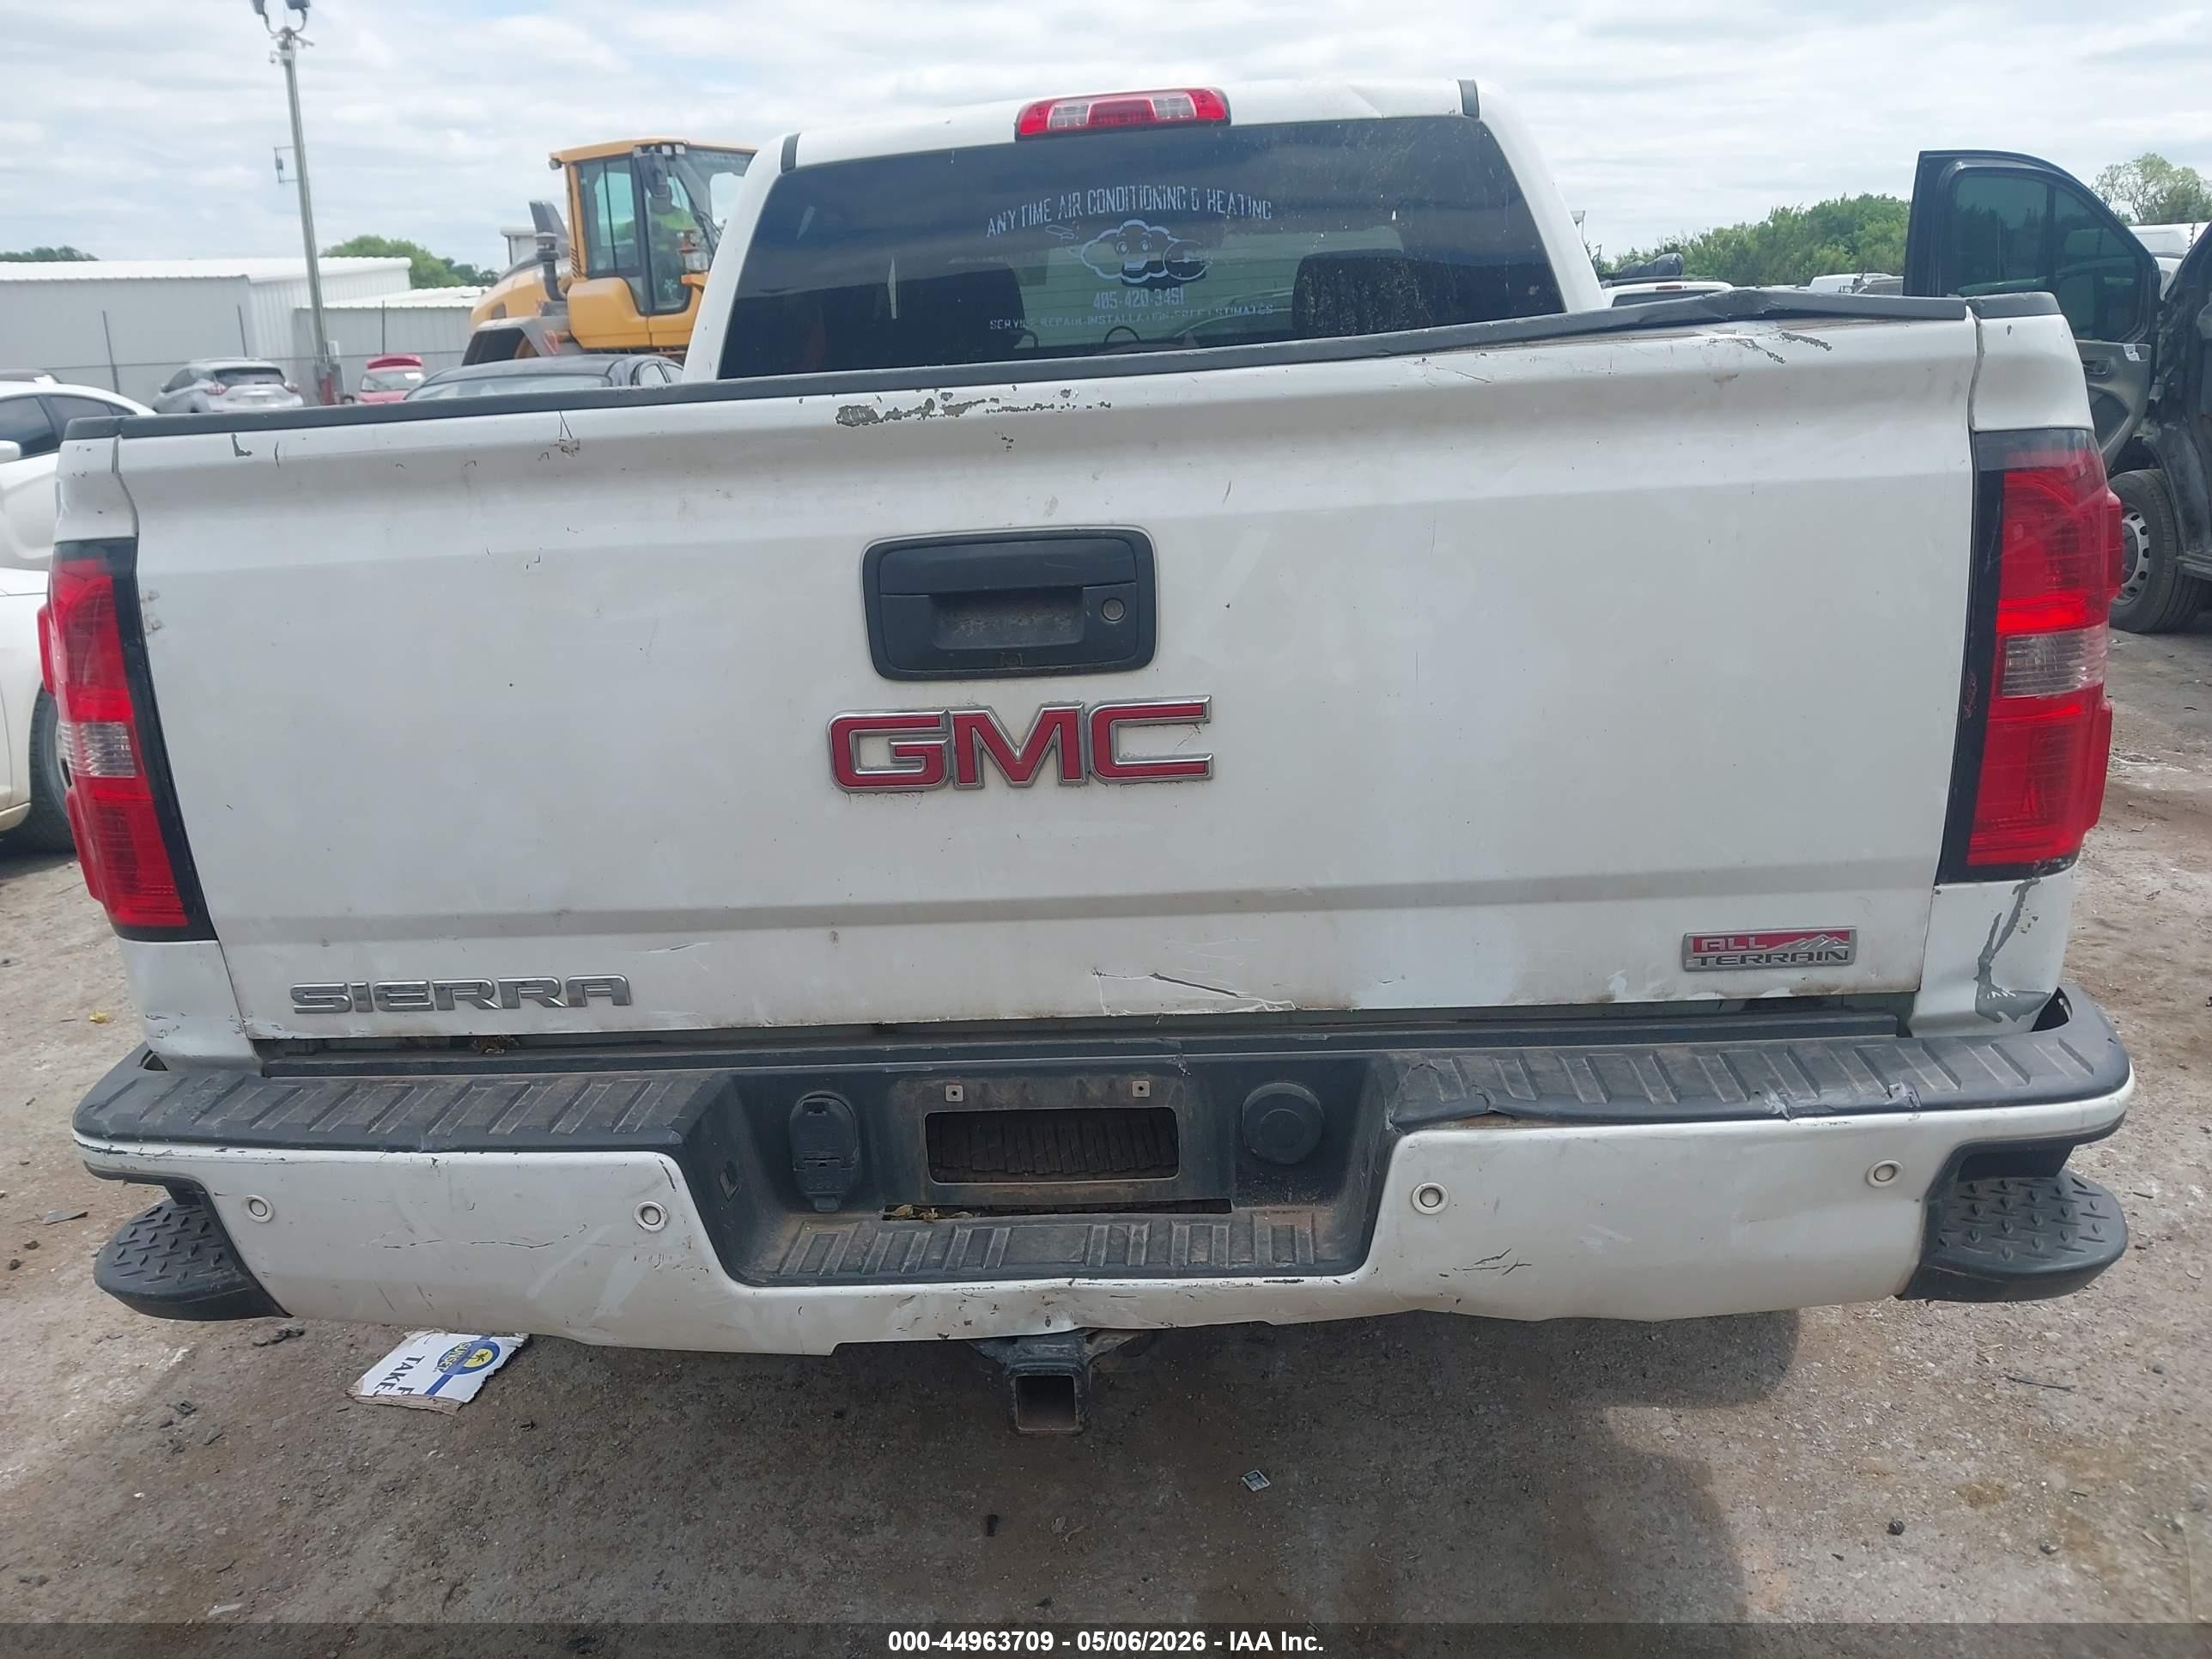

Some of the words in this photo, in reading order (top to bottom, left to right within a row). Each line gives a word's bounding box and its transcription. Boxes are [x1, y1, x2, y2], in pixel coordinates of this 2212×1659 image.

[1057, 191, 1084, 221] AIR
[1087, 185, 1187, 215] CONDITIONING
[1206, 187, 1272, 221] HEATING
[827, 695, 1214, 793] GMC
[1692, 951, 1849, 967] TERRAIN
[1700, 937, 1768, 951] ALL
[290, 975, 633, 1013] SIERRA
[374, 1355, 426, 1393] TAKE
